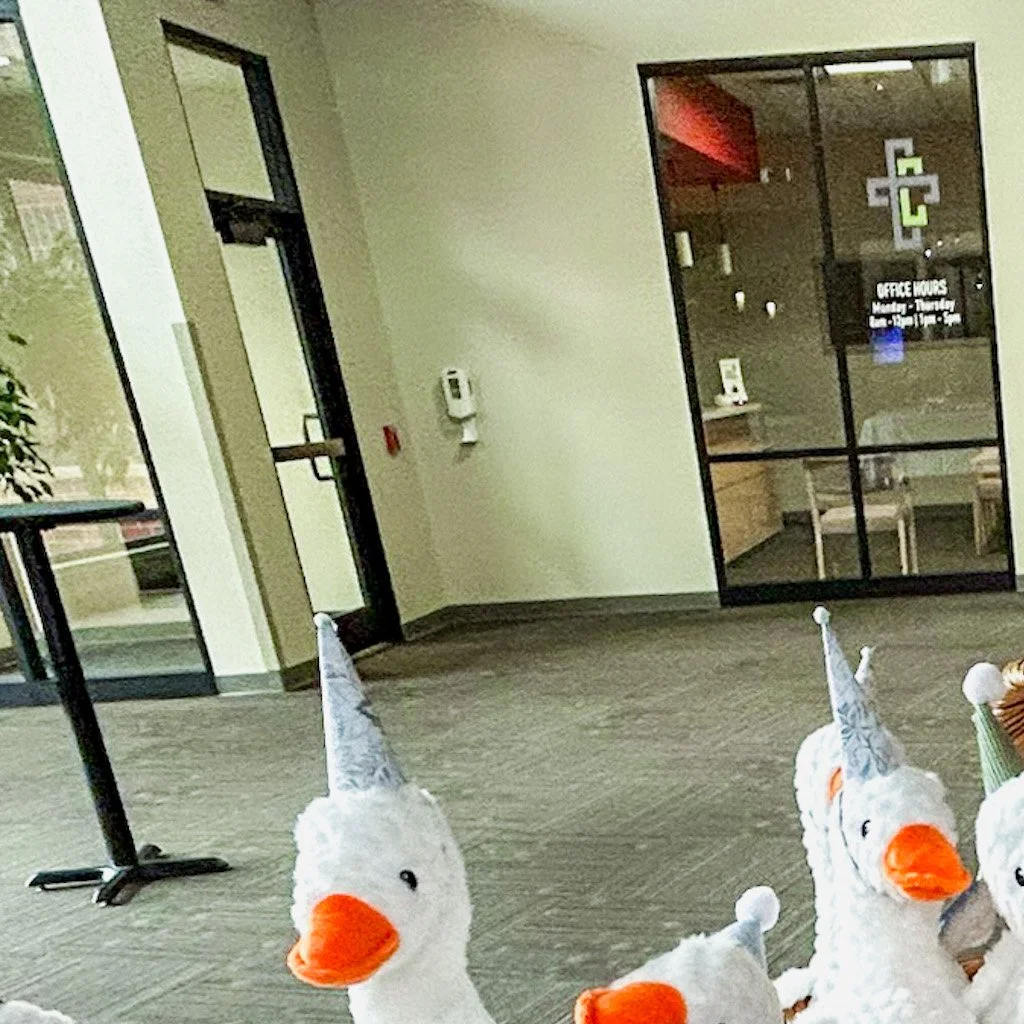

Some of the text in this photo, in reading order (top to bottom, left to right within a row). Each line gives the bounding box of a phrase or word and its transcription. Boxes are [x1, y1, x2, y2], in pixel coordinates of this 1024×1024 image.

[877, 279, 948, 299] OFFICE HOURS
[871, 301, 907, 315] Monday
[914, 298, 955, 313] Thursday
